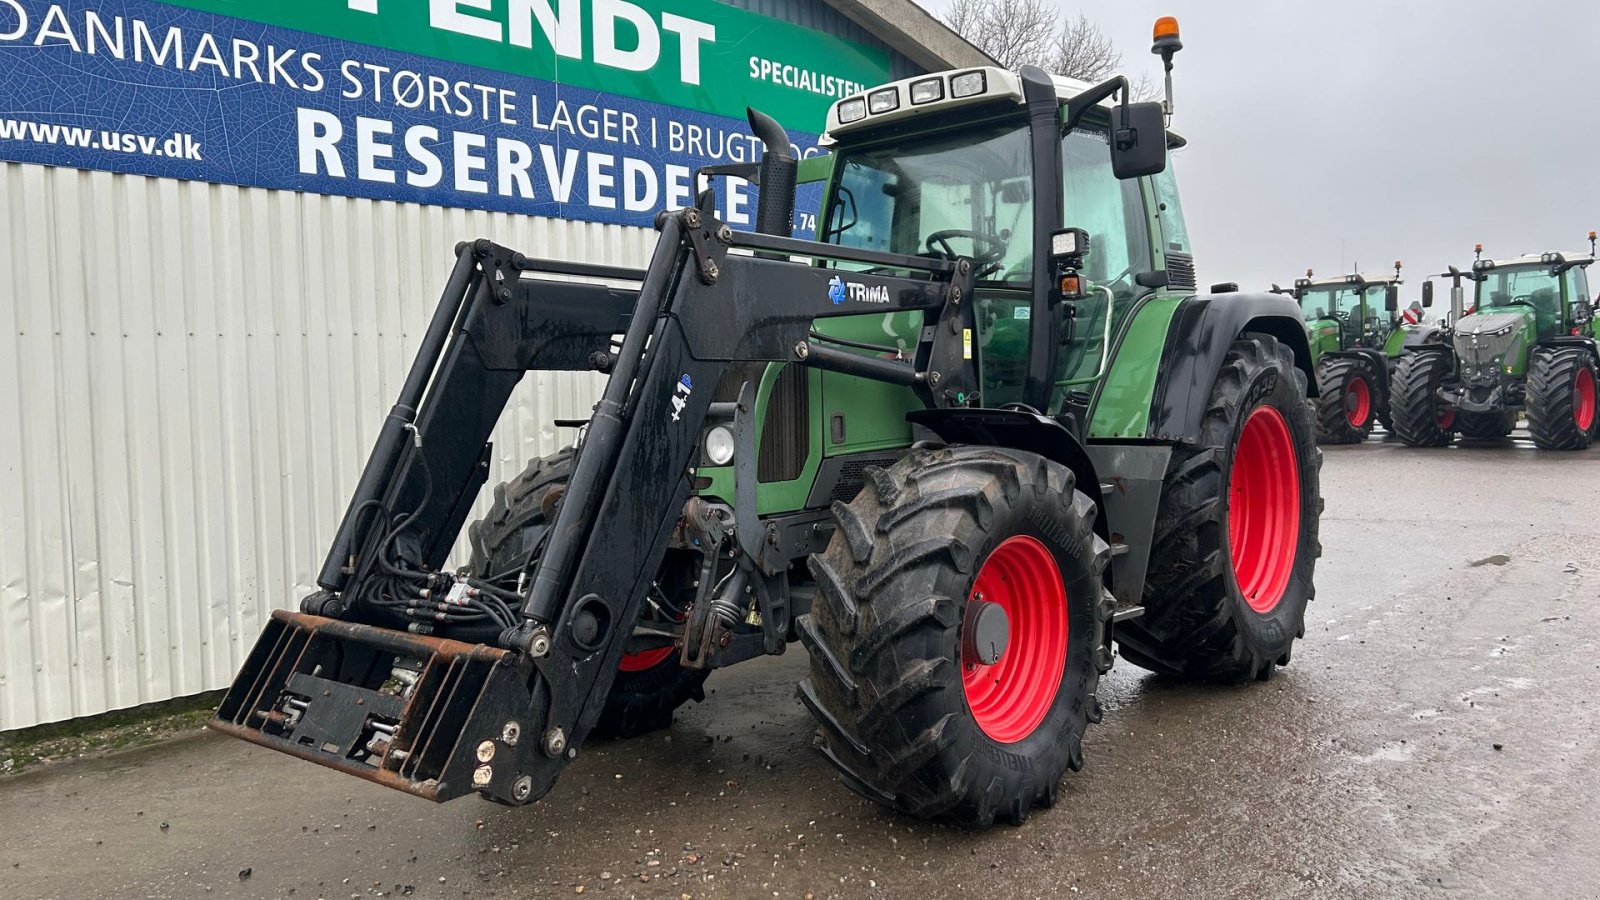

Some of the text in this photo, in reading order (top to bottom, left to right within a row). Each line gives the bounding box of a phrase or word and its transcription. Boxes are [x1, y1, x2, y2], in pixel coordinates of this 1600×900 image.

[0, 0, 769, 163] DANMARKS STØRSTE LAGER I BRUGT
[348, 0, 716, 86] ENDT
[0, 118, 202, 160] www.usv.dk
